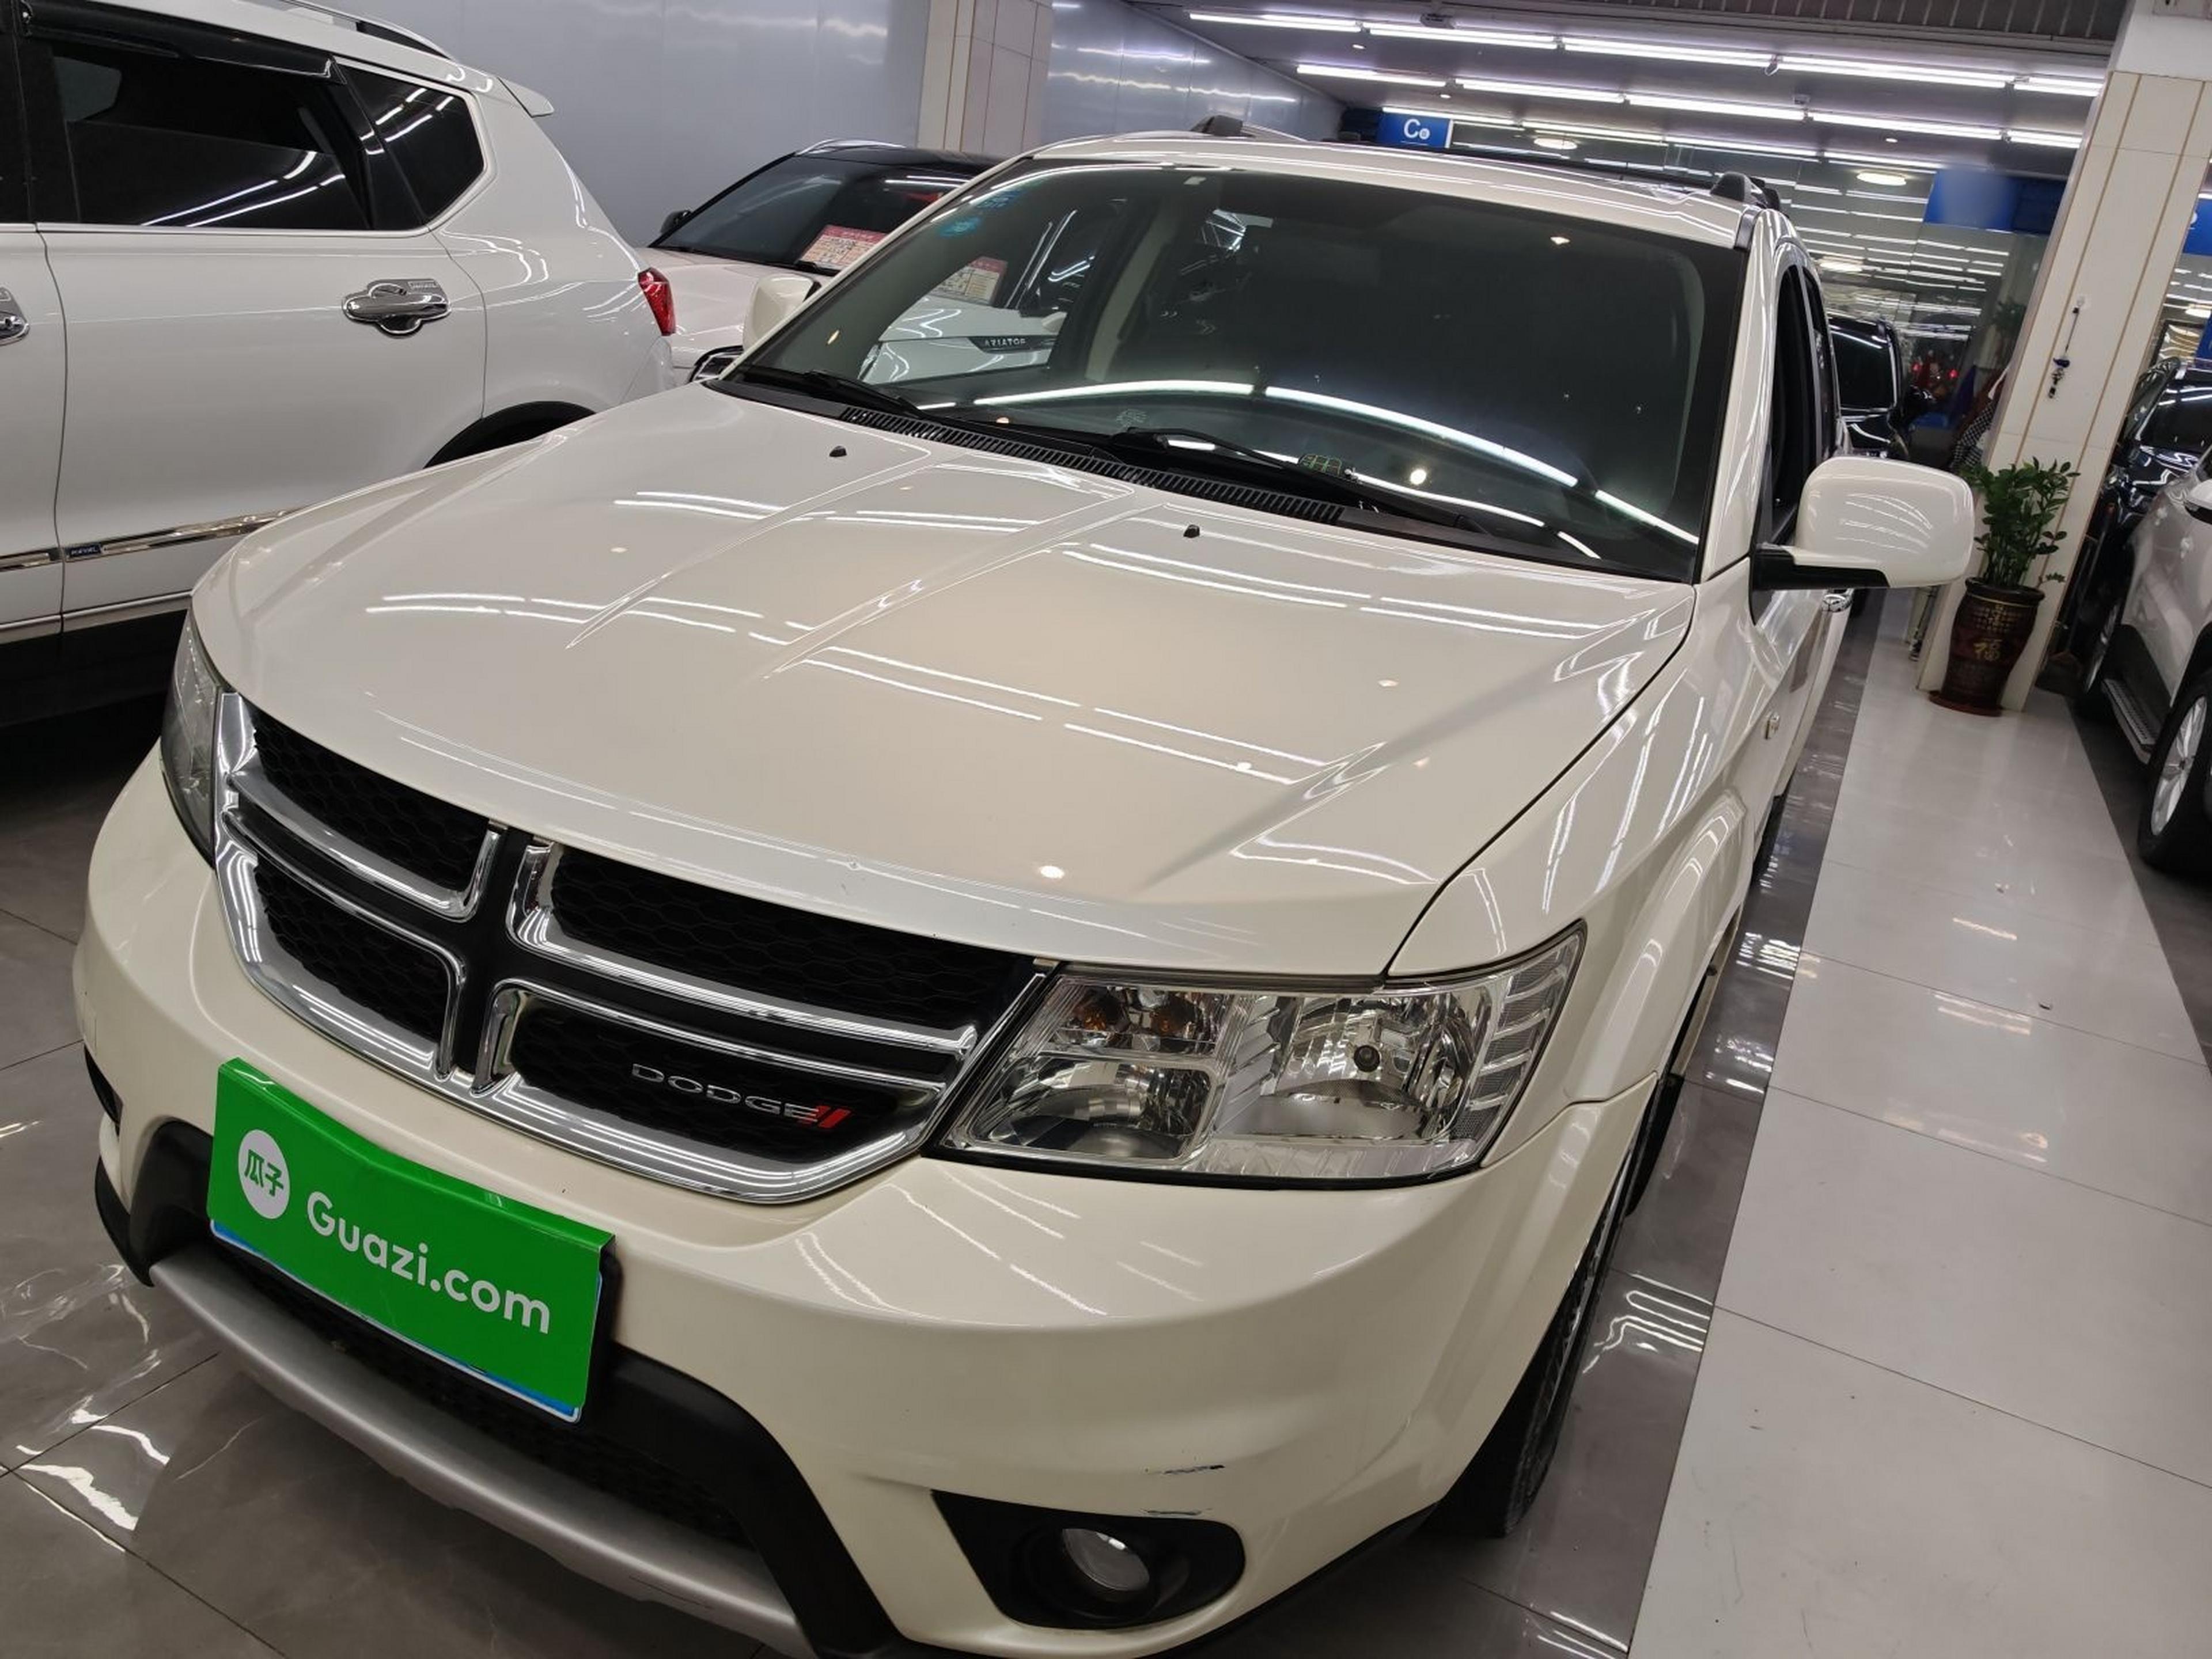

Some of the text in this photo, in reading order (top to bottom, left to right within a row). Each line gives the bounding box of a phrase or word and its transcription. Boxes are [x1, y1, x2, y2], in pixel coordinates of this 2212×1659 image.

[632, 1063, 819, 1122] DODGE
[244, 1149, 285, 1197] 瓜子
[306, 1191, 550, 1334] Guazi.com
